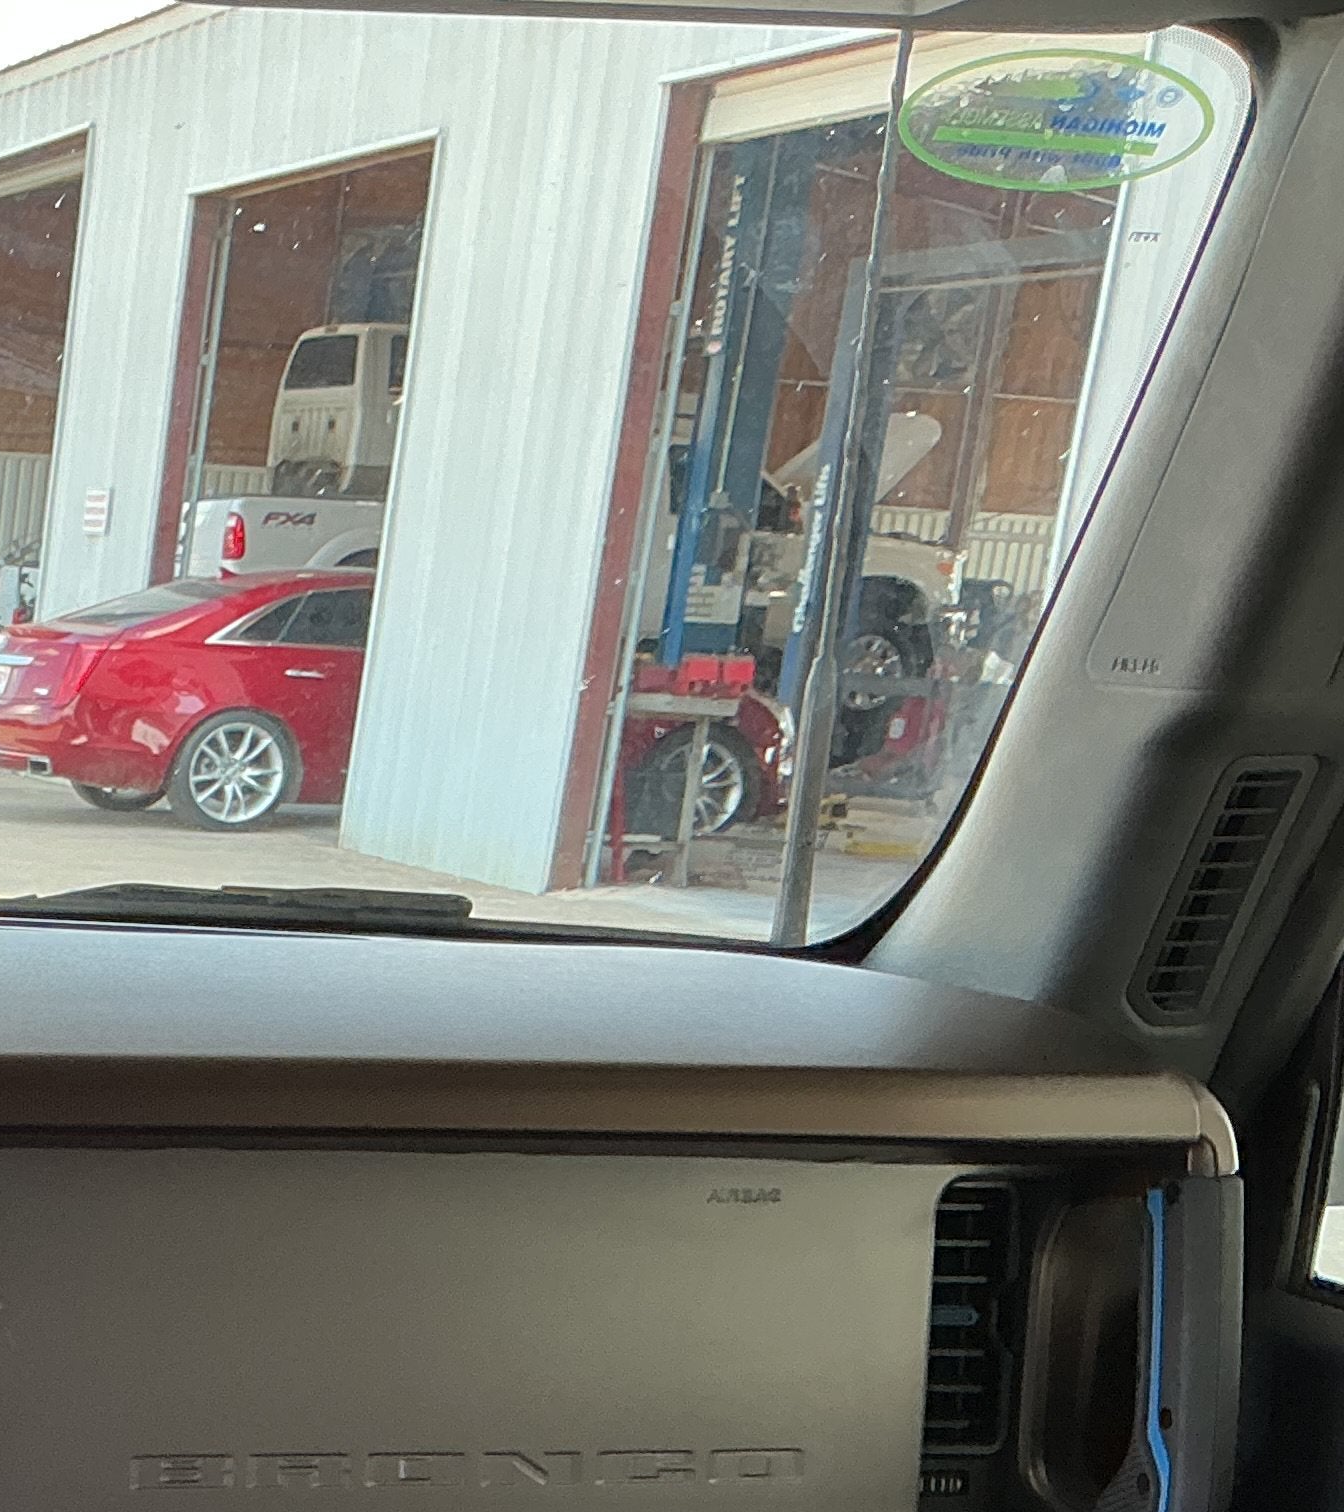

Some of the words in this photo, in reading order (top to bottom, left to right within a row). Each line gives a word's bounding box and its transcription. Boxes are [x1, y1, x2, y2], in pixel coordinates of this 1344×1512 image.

[712, 235, 737, 336] ROTARY
[728, 174, 745, 228] LIFT
[262, 511, 317, 526] FX4
[129, 1448, 805, 1489] BRONCO
